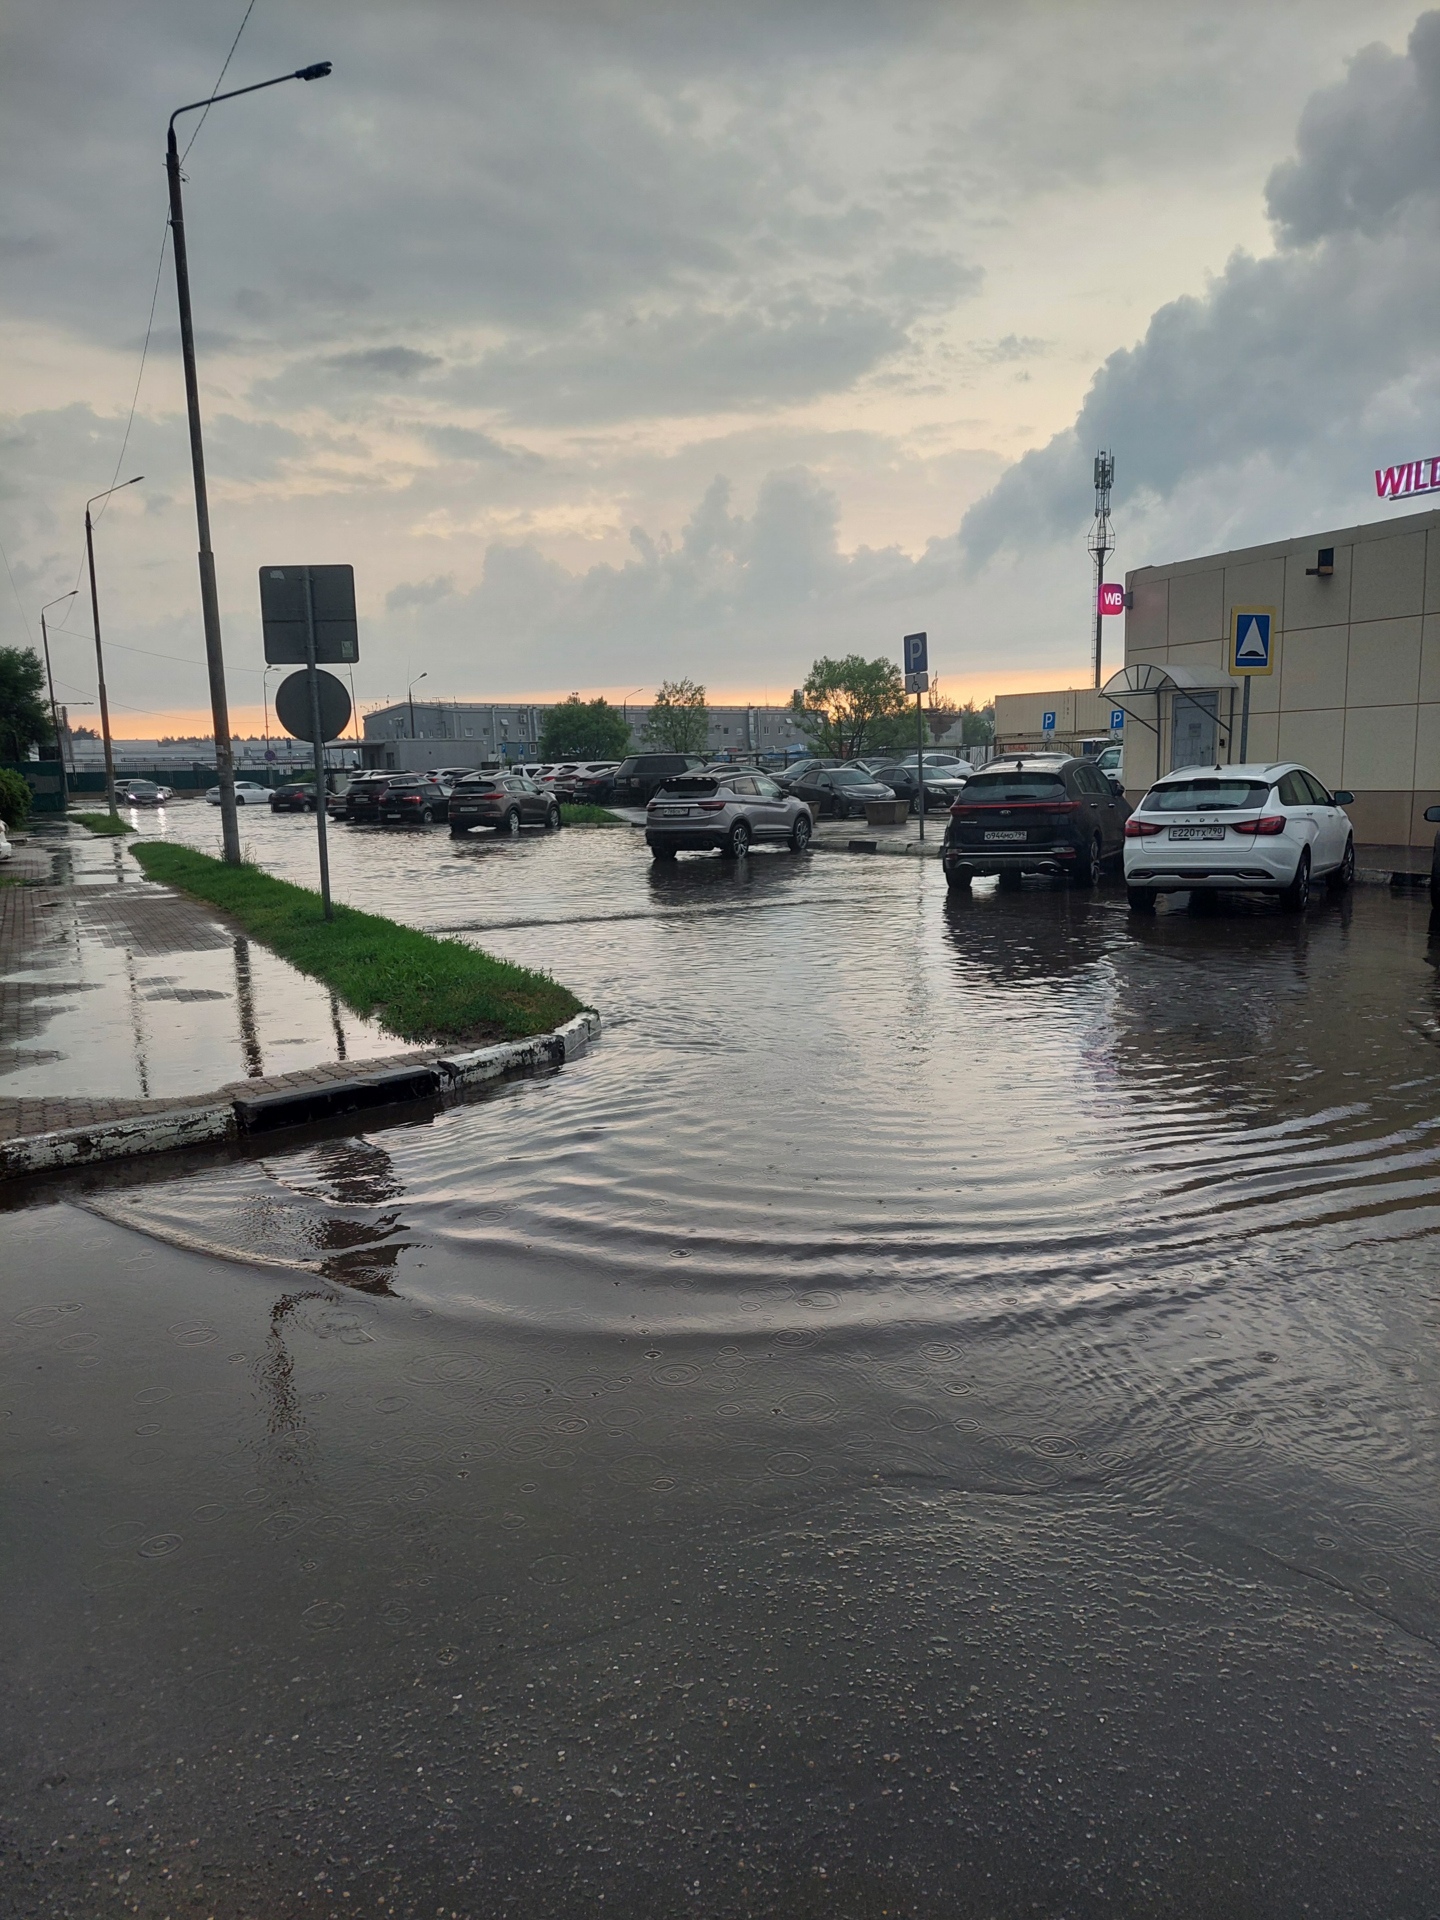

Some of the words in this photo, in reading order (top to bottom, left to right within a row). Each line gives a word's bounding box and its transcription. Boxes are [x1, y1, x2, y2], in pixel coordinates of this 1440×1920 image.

[1104, 592, 1122, 605] WB
[910, 639, 922, 669] P
[1044, 714, 1053, 728] P
[1113, 712, 1122, 727] P
